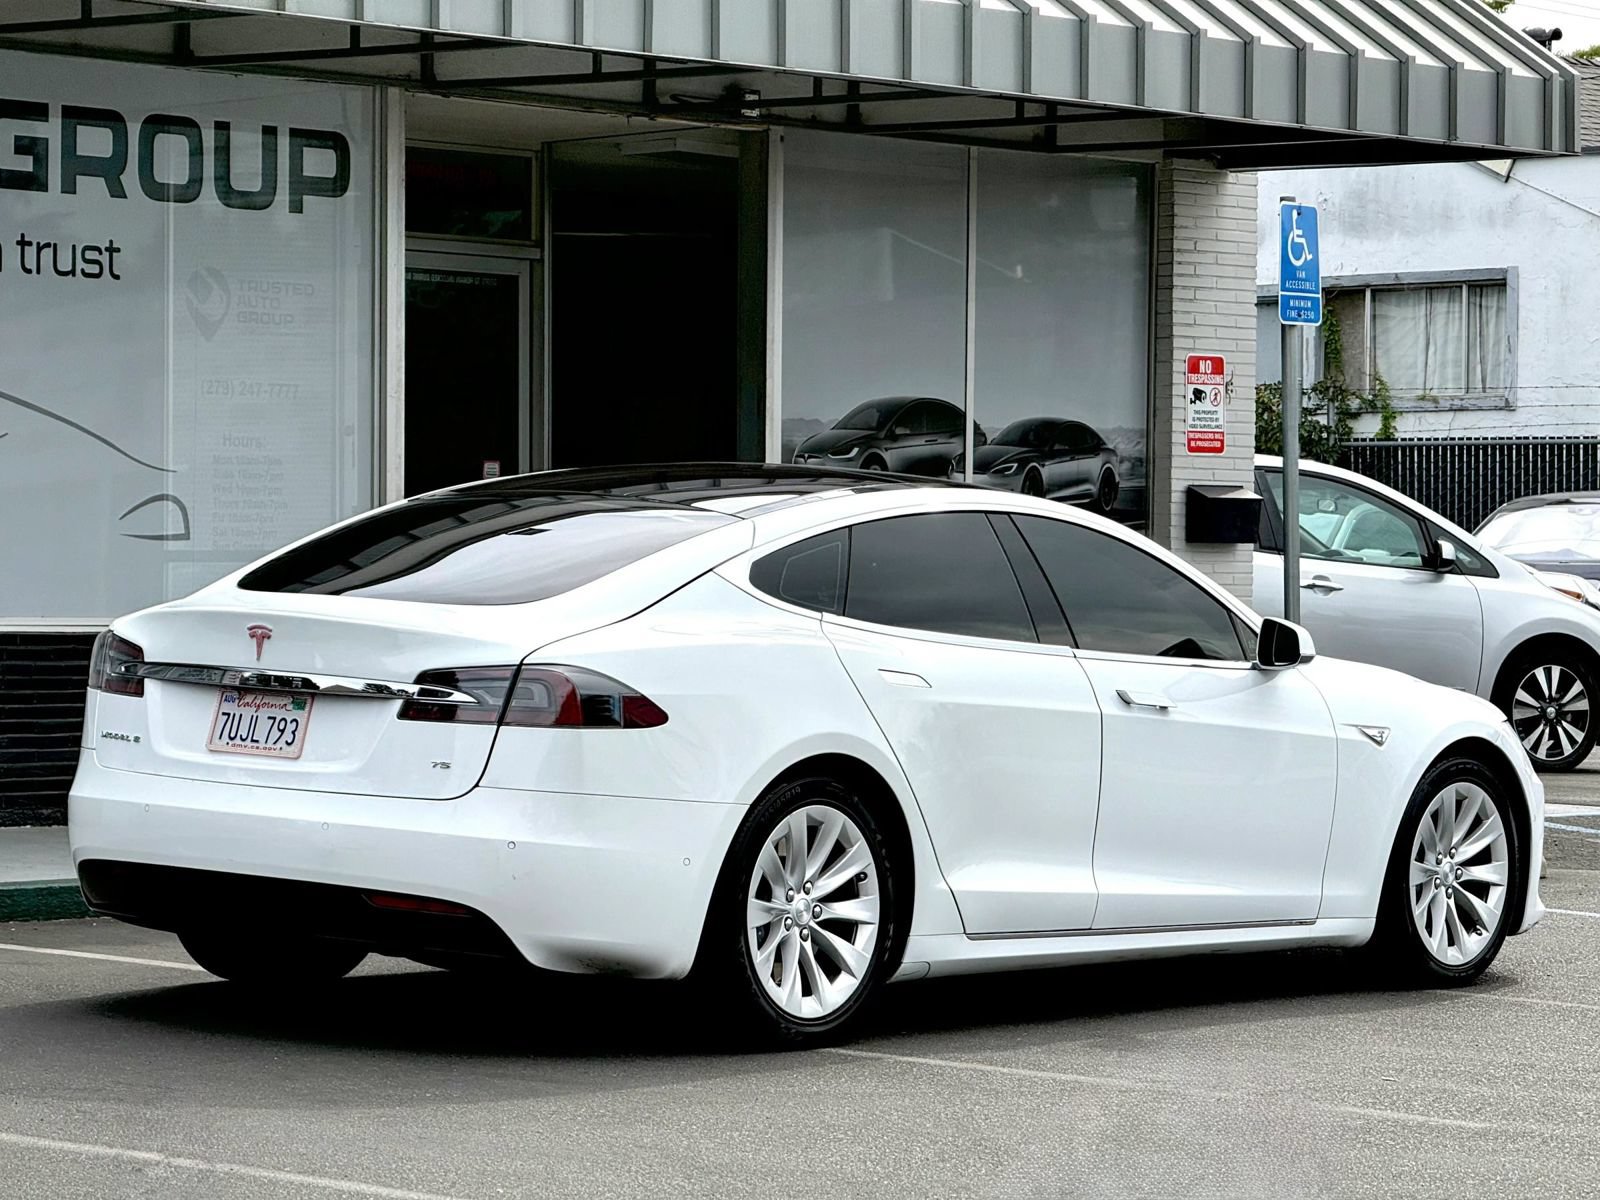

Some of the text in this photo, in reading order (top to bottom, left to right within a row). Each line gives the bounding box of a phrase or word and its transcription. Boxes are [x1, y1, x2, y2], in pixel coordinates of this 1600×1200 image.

[0, 97, 350, 214] GROUP
[16, 233, 121, 280] trust
[1296, 270, 1306, 278] VAN
[237, 279, 315, 297] TRUSTED
[1285, 280, 1316, 290] ACCESSIBLE
[237, 295, 281, 310] AUTO
[1289, 299, 1312, 308] MINIMUM
[237, 311, 295, 326] GROUP
[1286, 309, 1315, 319] FINE $250
[1199, 359, 1212, 374] NO
[1188, 373, 1224, 385] TRESPASSING
[239, 380, 301, 400] 247-7777
[223, 694, 237, 703] AUG
[237, 694, 292, 713] California
[431, 761, 452, 770] 75
